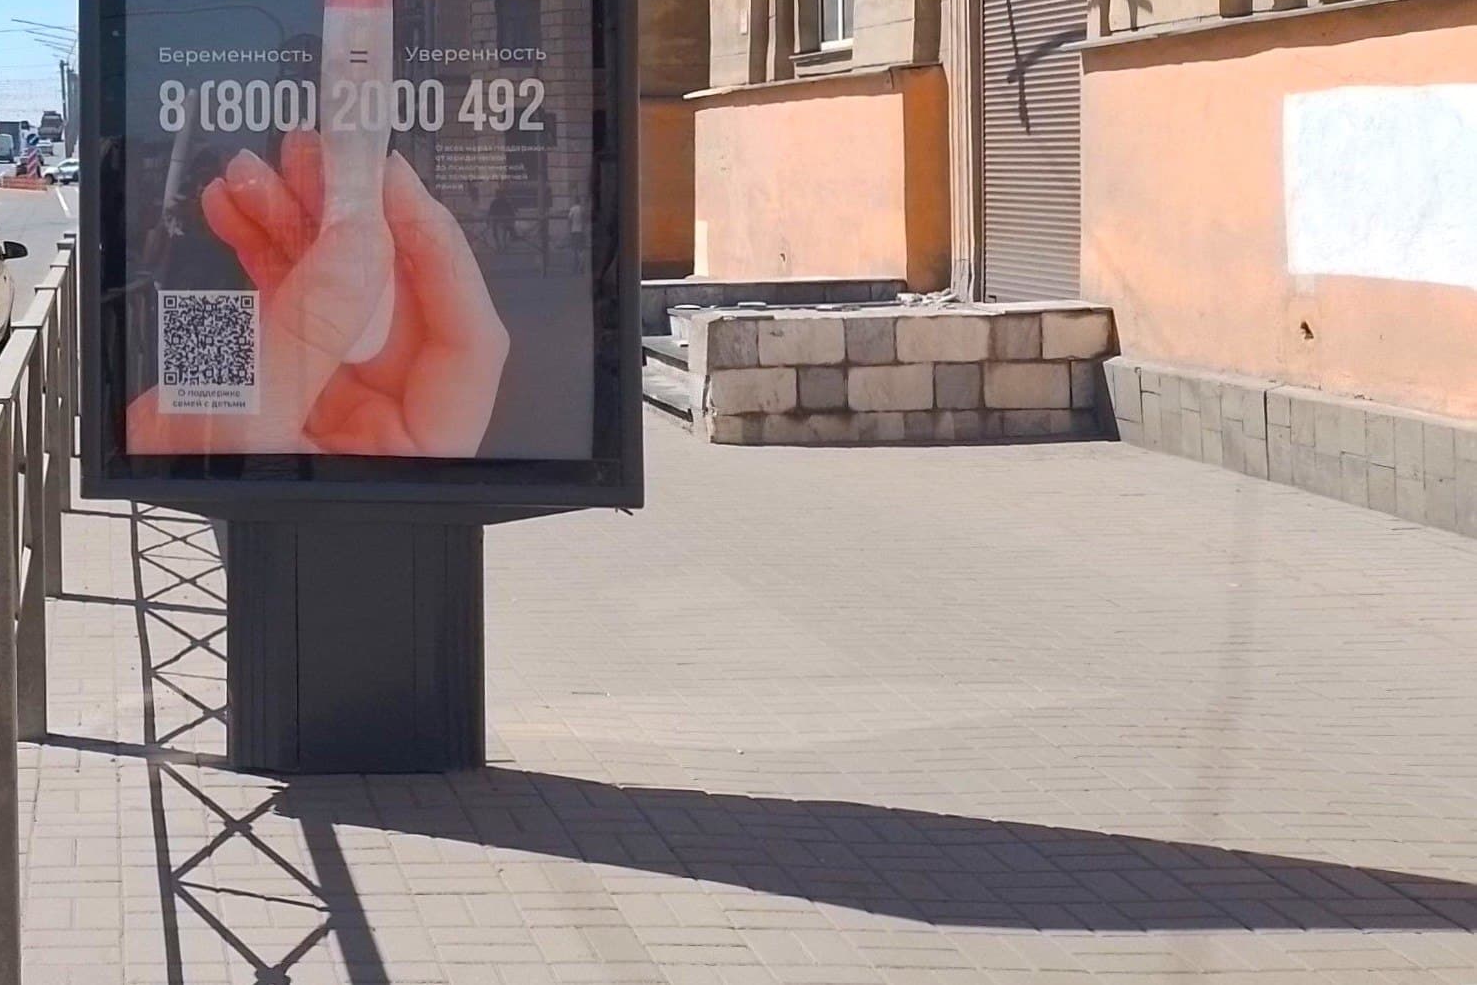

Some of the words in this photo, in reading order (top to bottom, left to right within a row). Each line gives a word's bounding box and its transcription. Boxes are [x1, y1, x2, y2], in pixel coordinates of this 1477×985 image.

[158, 47, 313, 66] Беременность
[405, 46, 547, 65] Уверенность
[159, 79, 186, 132] 8
[200, 79, 317, 132] (800)
[332, 78, 445, 133] 2000
[458, 78, 545, 132] 492
[172, 399, 202, 408] семей
[211, 401, 246, 409] детьми
